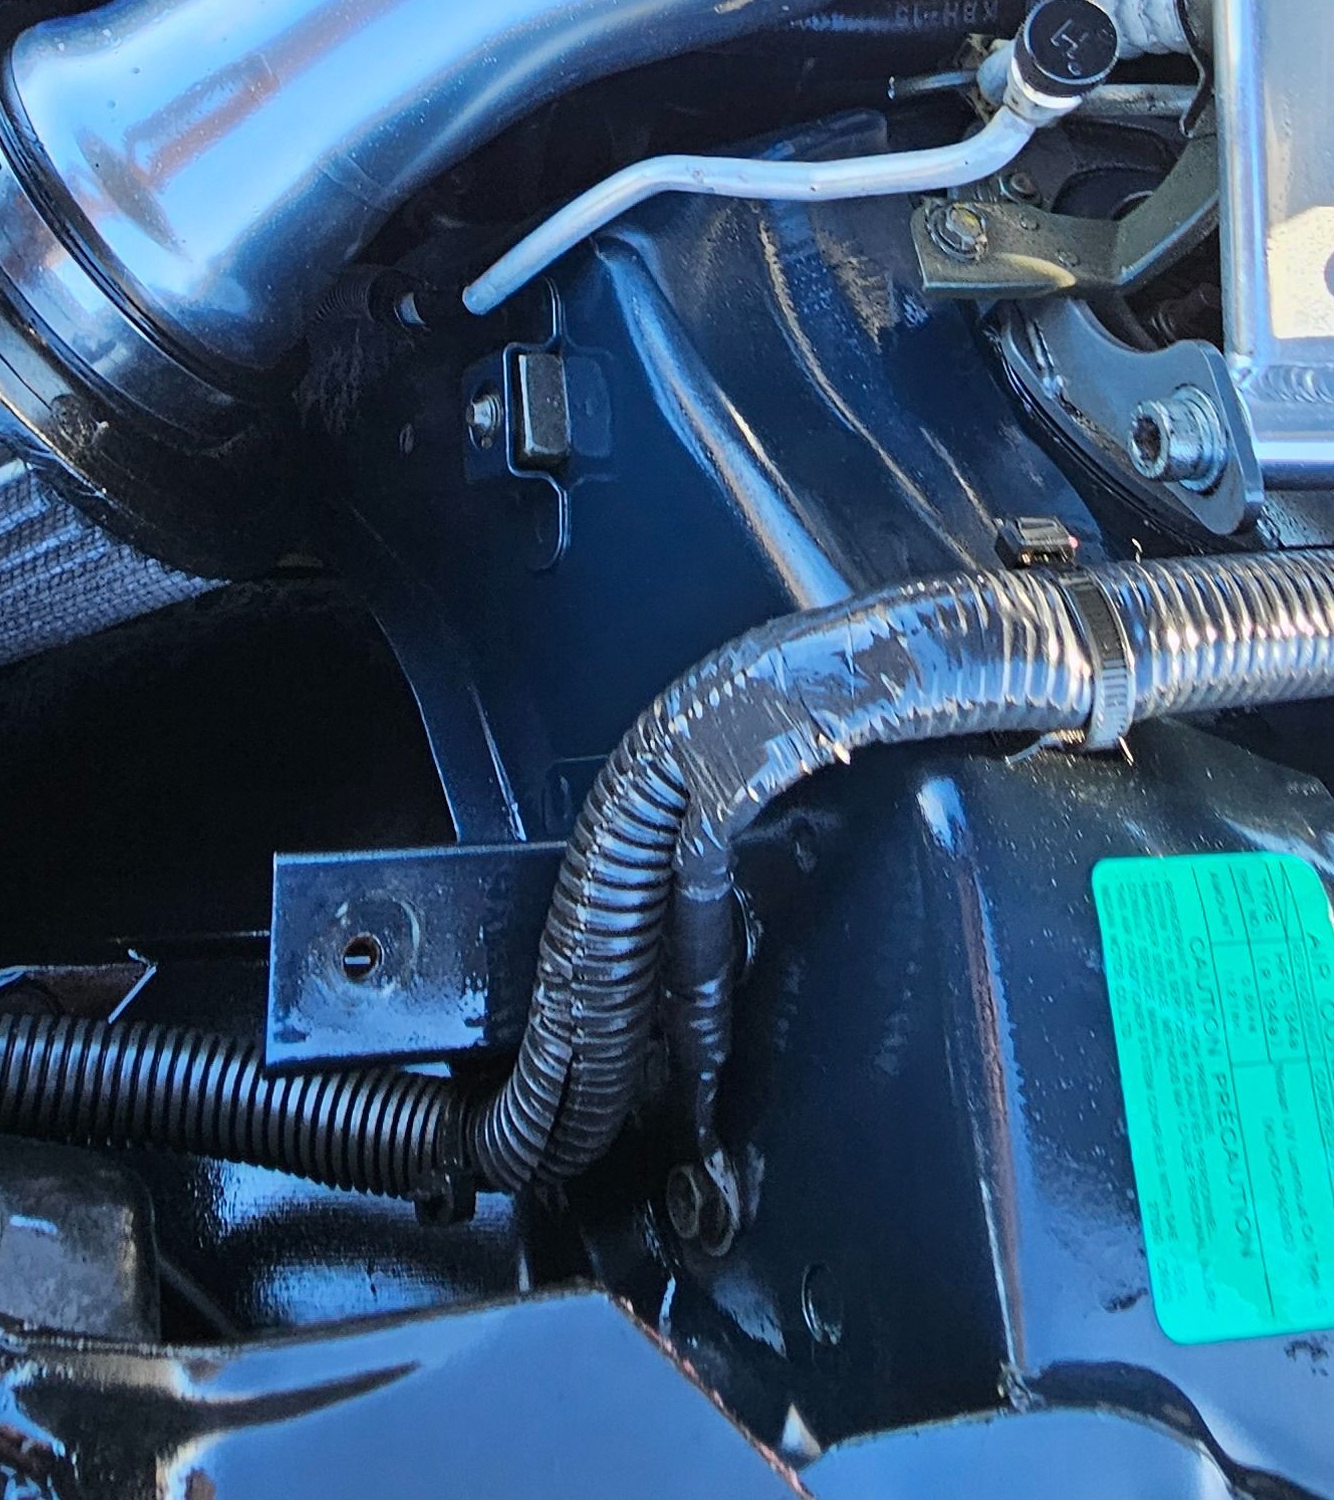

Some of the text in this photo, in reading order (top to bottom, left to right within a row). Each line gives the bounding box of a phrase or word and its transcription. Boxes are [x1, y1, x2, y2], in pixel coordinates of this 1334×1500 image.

[1256, 876, 1279, 925] TYPE
[1305, 929, 1331, 982] AIR
[1185, 934, 1257, 1259] CAUTION PRÉCAUTION
